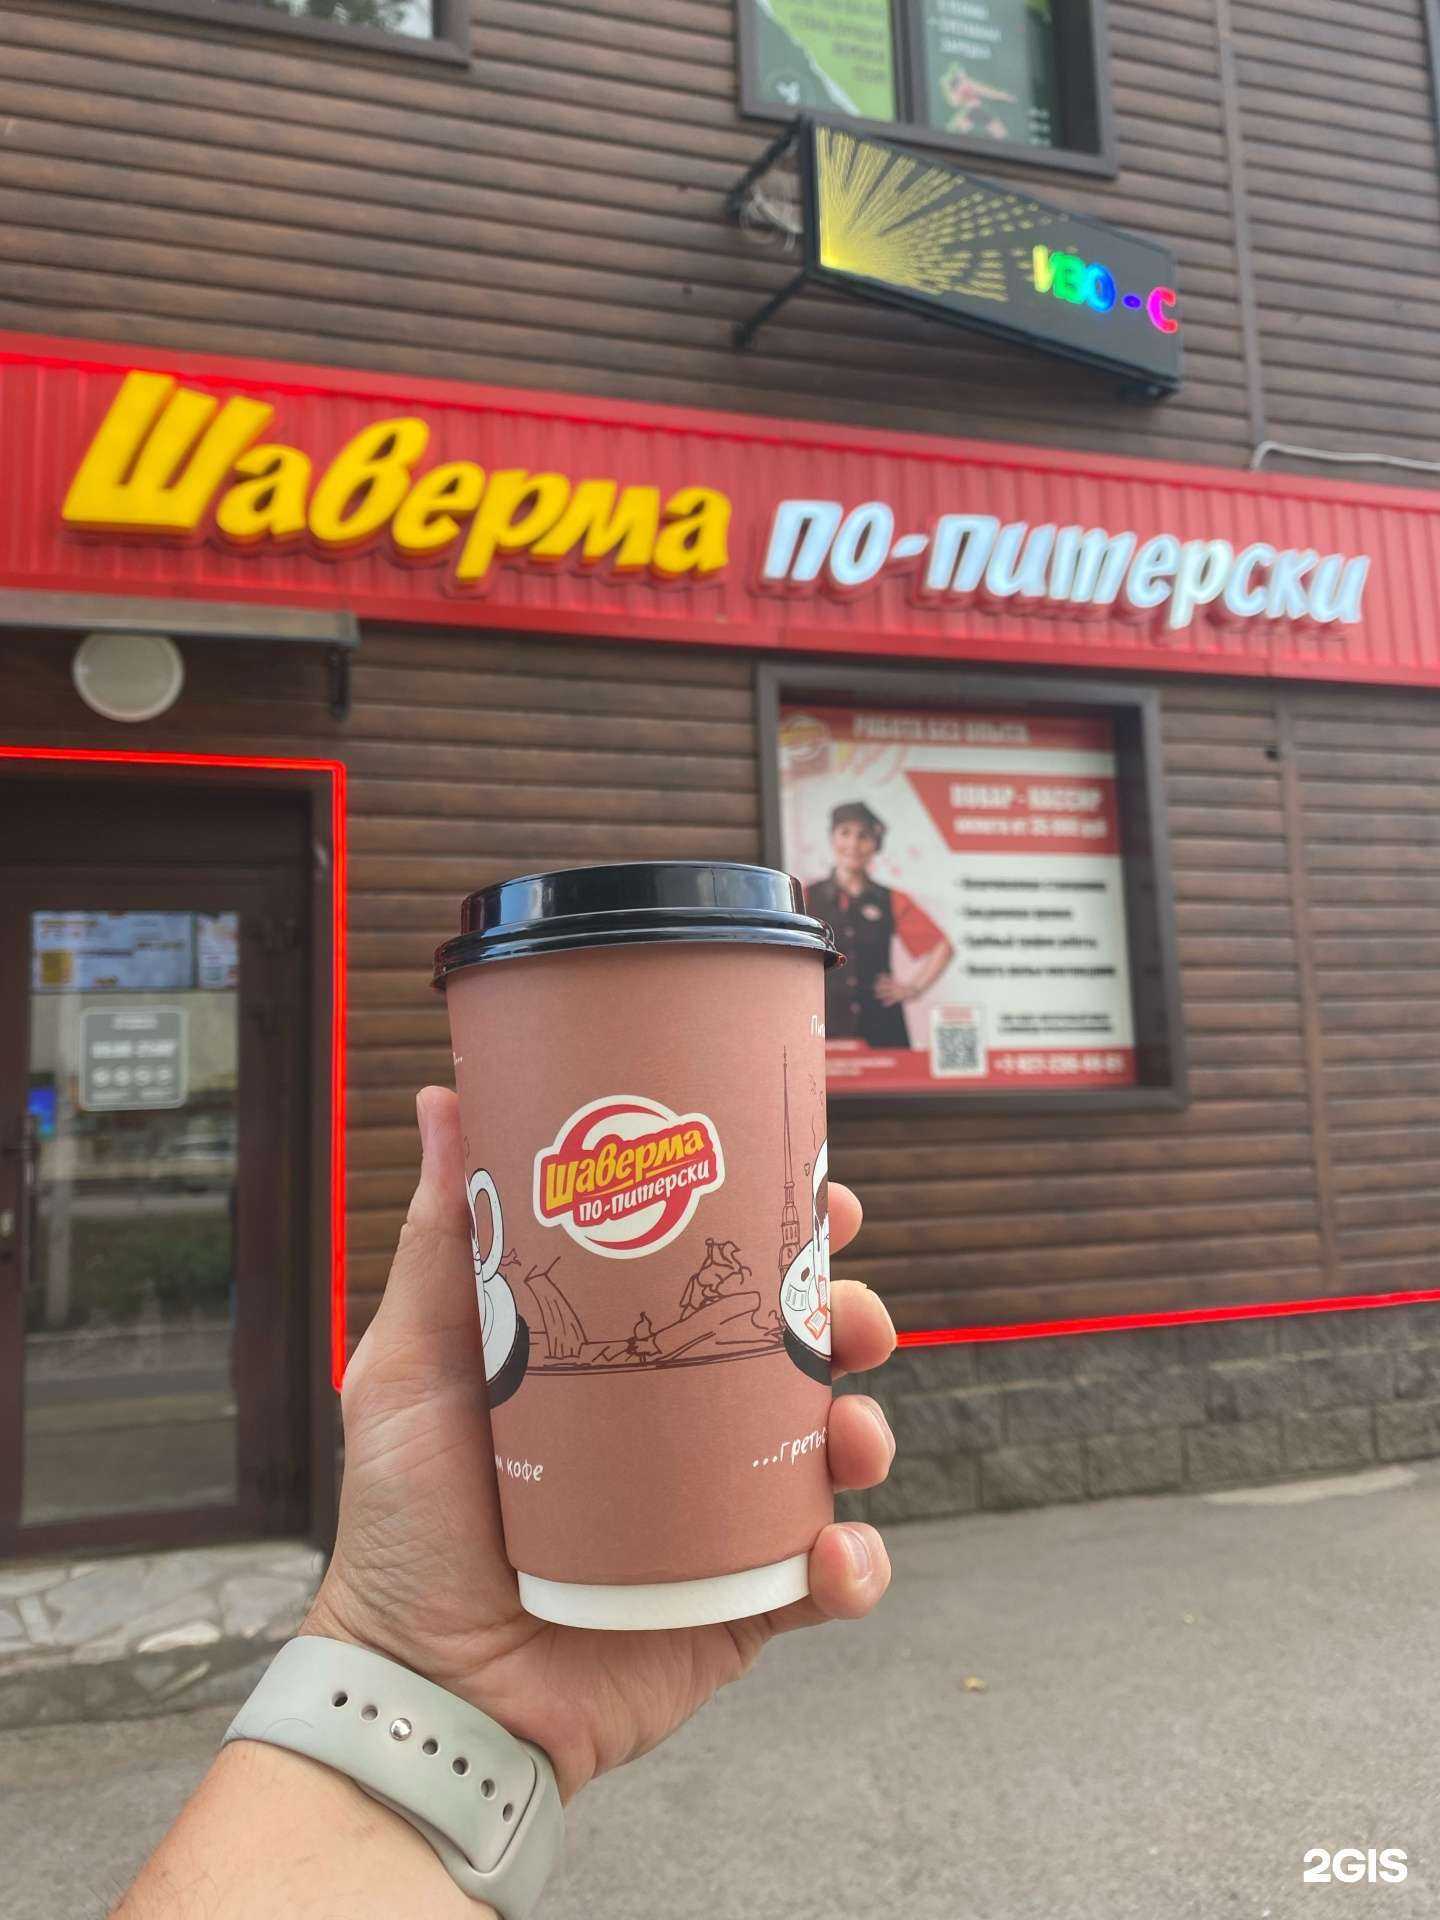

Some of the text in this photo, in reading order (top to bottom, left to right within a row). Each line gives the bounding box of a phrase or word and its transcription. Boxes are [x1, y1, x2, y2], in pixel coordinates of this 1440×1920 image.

[62, 370, 1370, 629] Шаверма по-питерски
[546, 1129, 705, 1211] Шаверма
[579, 1160, 710, 1222] по-питерски
[506, 1457, 544, 1483] кофе
